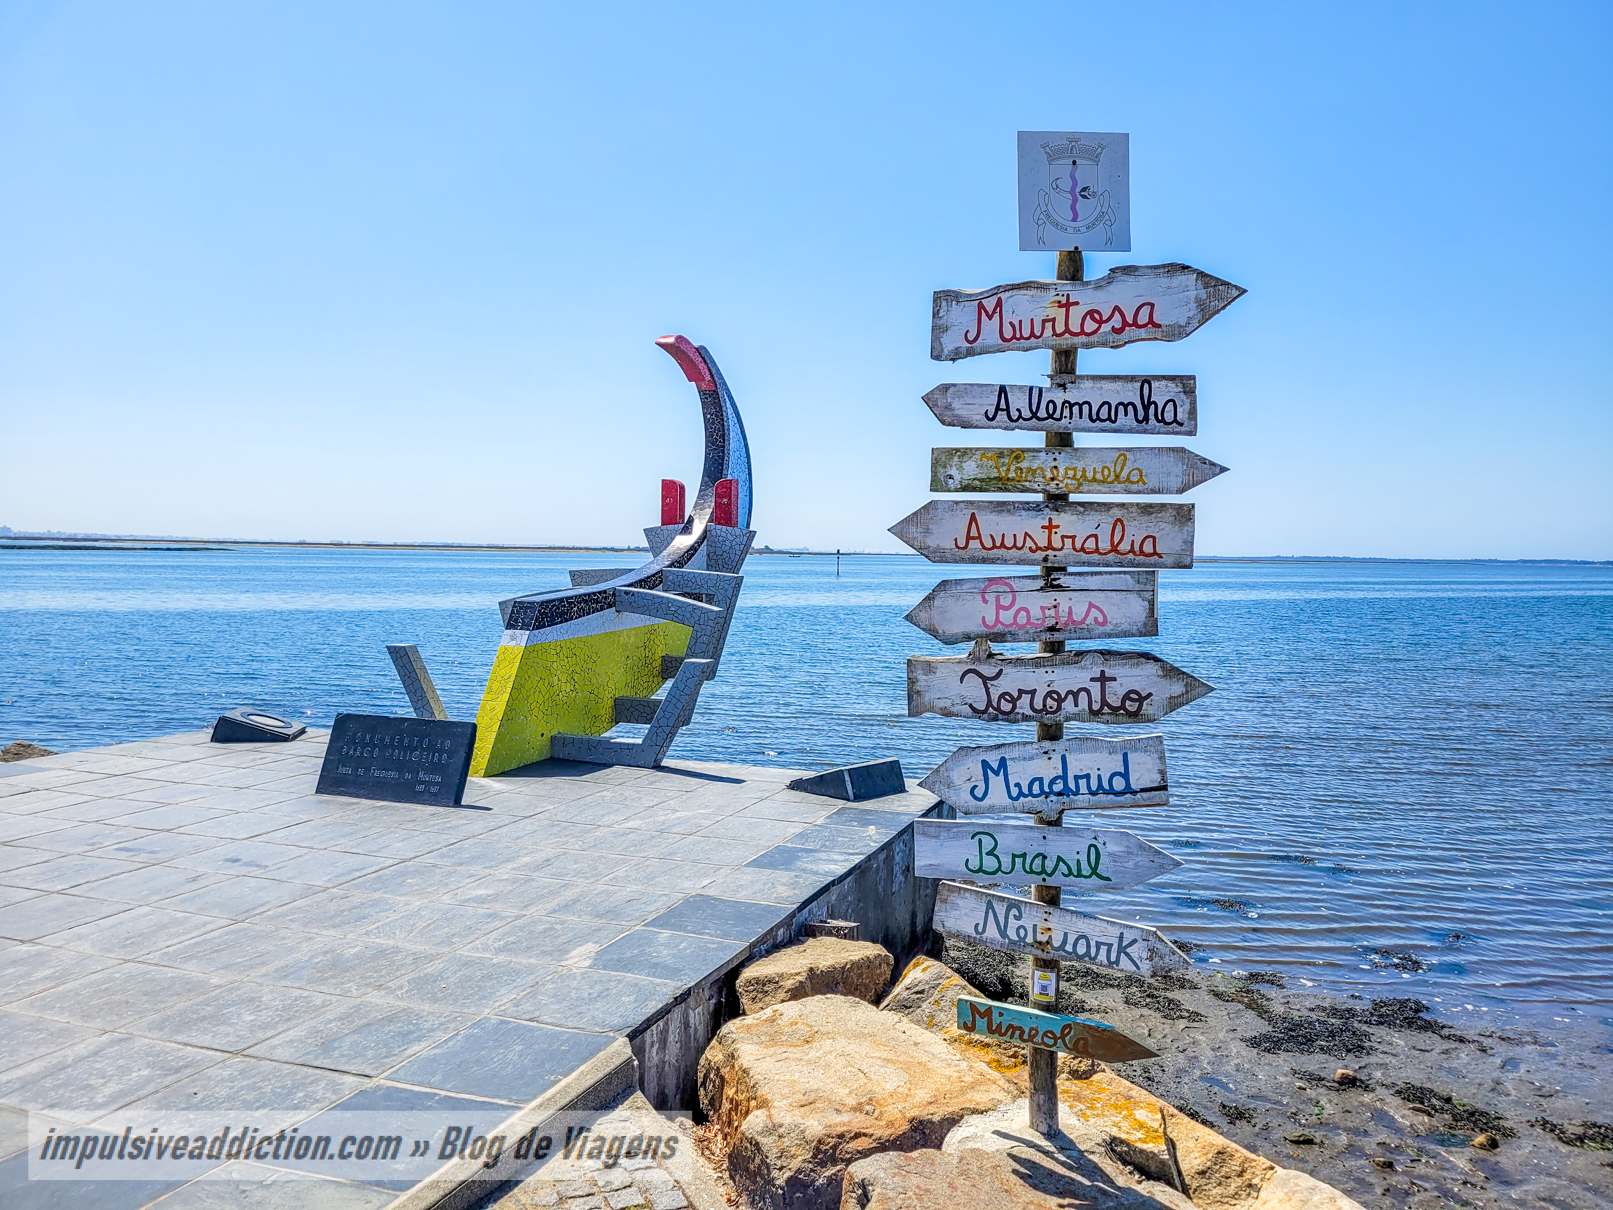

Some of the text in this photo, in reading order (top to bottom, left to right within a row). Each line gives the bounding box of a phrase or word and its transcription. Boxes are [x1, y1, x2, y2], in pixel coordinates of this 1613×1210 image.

[1085, 211, 1106, 231] MURTOSA
[964, 294, 1162, 344] Murtosa
[984, 379, 1184, 427] Alemanha
[980, 451, 1147, 492] Venezuela
[954, 512, 1163, 559] Austrália
[981, 579, 1108, 630] Paris
[959, 668, 1153, 716] Toronto
[341, 745, 379, 758] BARCO
[970, 752, 1140, 802] Madrid
[964, 831, 1112, 881] Brasil
[974, 899, 1141, 971] Newark
[963, 1003, 1094, 1059] Mineola
